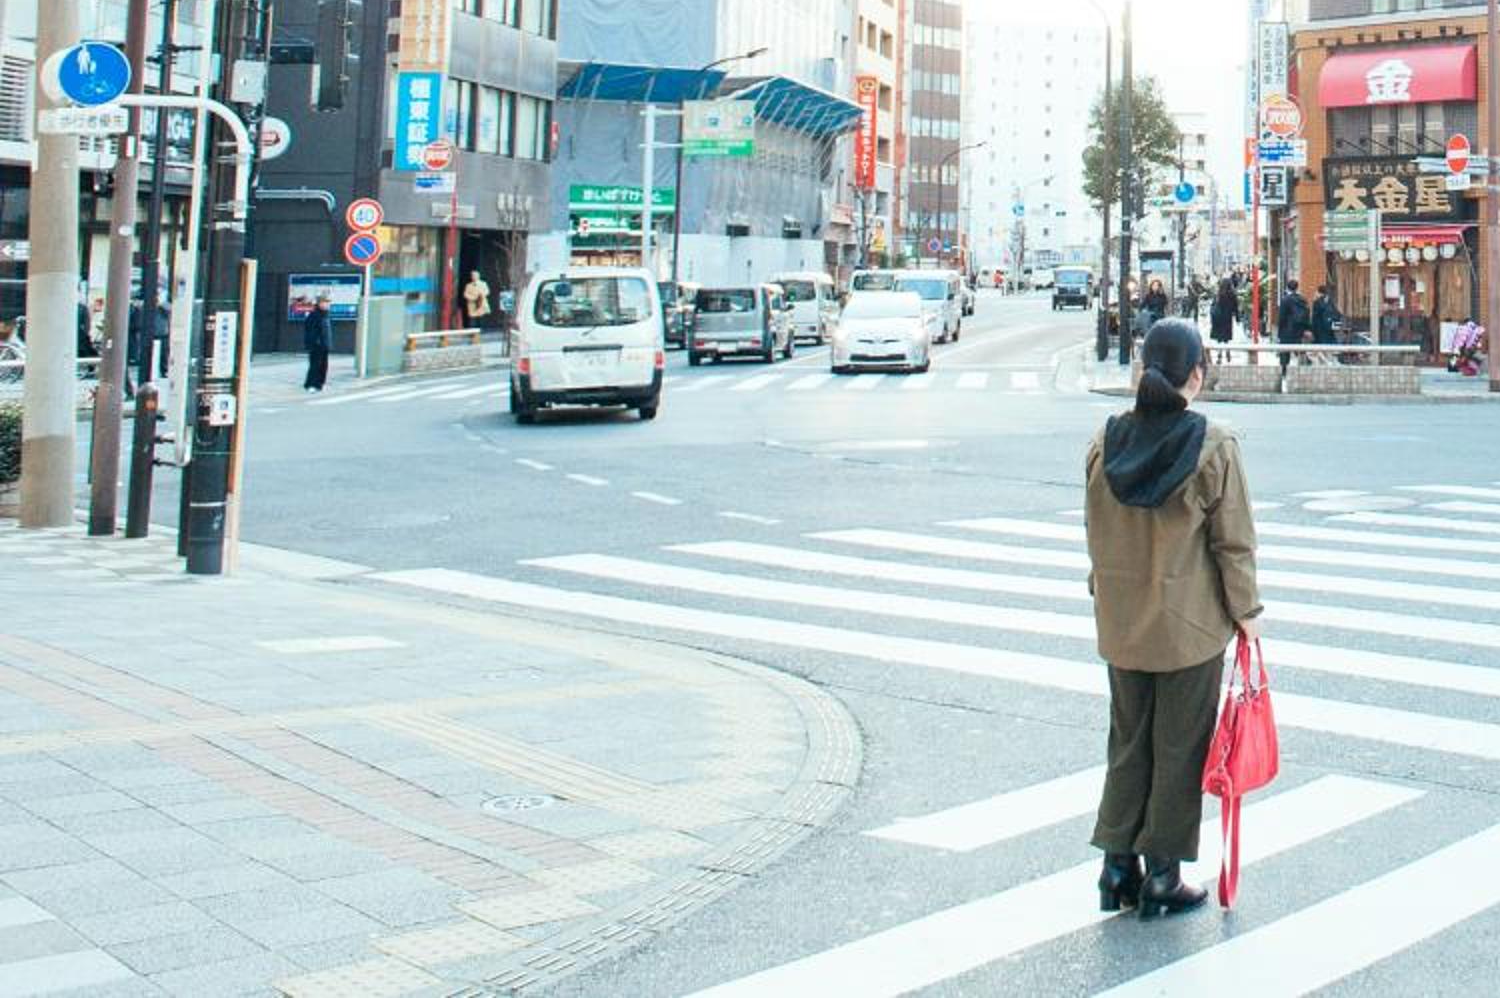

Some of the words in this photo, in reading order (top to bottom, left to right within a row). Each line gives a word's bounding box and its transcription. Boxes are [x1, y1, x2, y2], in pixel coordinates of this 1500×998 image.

[1365, 59, 1414, 103] 金
[1333, 175, 1452, 216] 大金星
